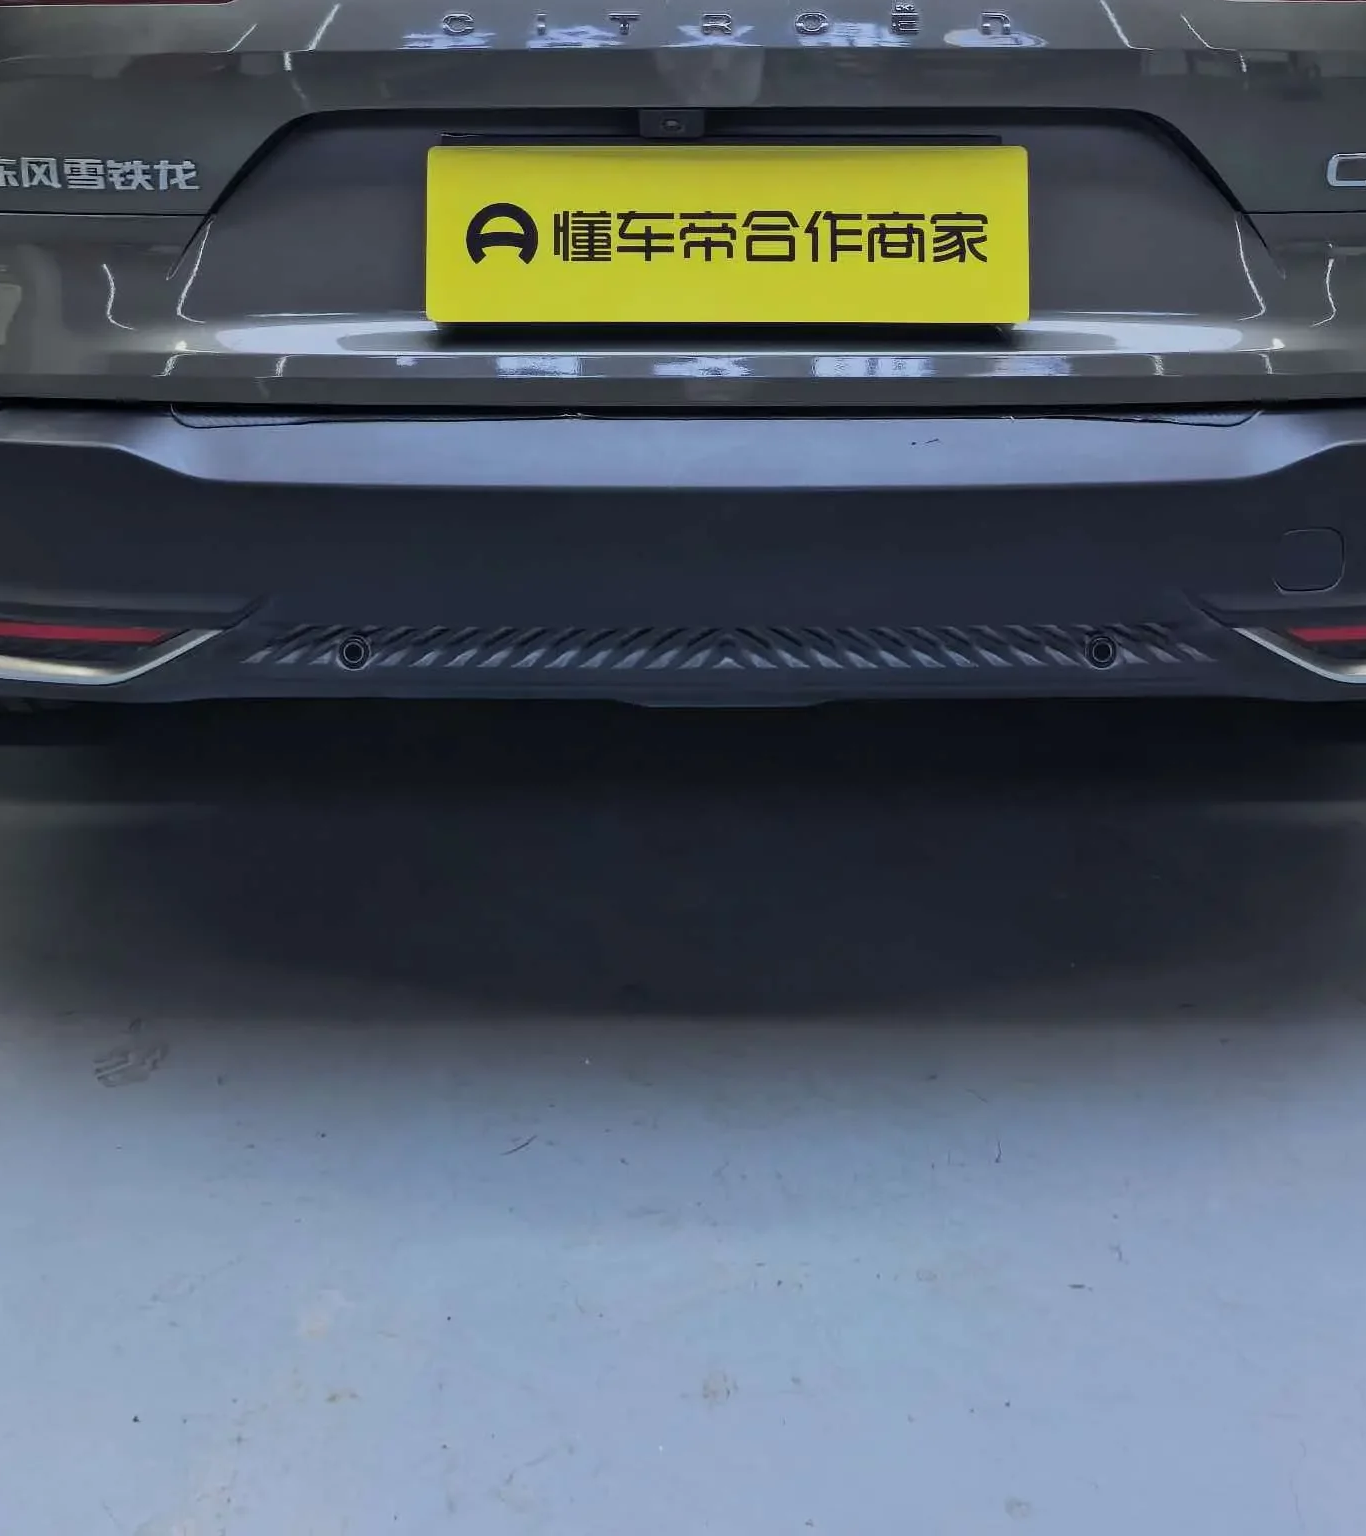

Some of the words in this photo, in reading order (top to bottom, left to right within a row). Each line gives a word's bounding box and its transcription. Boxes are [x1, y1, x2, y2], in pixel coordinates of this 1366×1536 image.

[552, 209, 989, 263] 懂车帝合作商家
